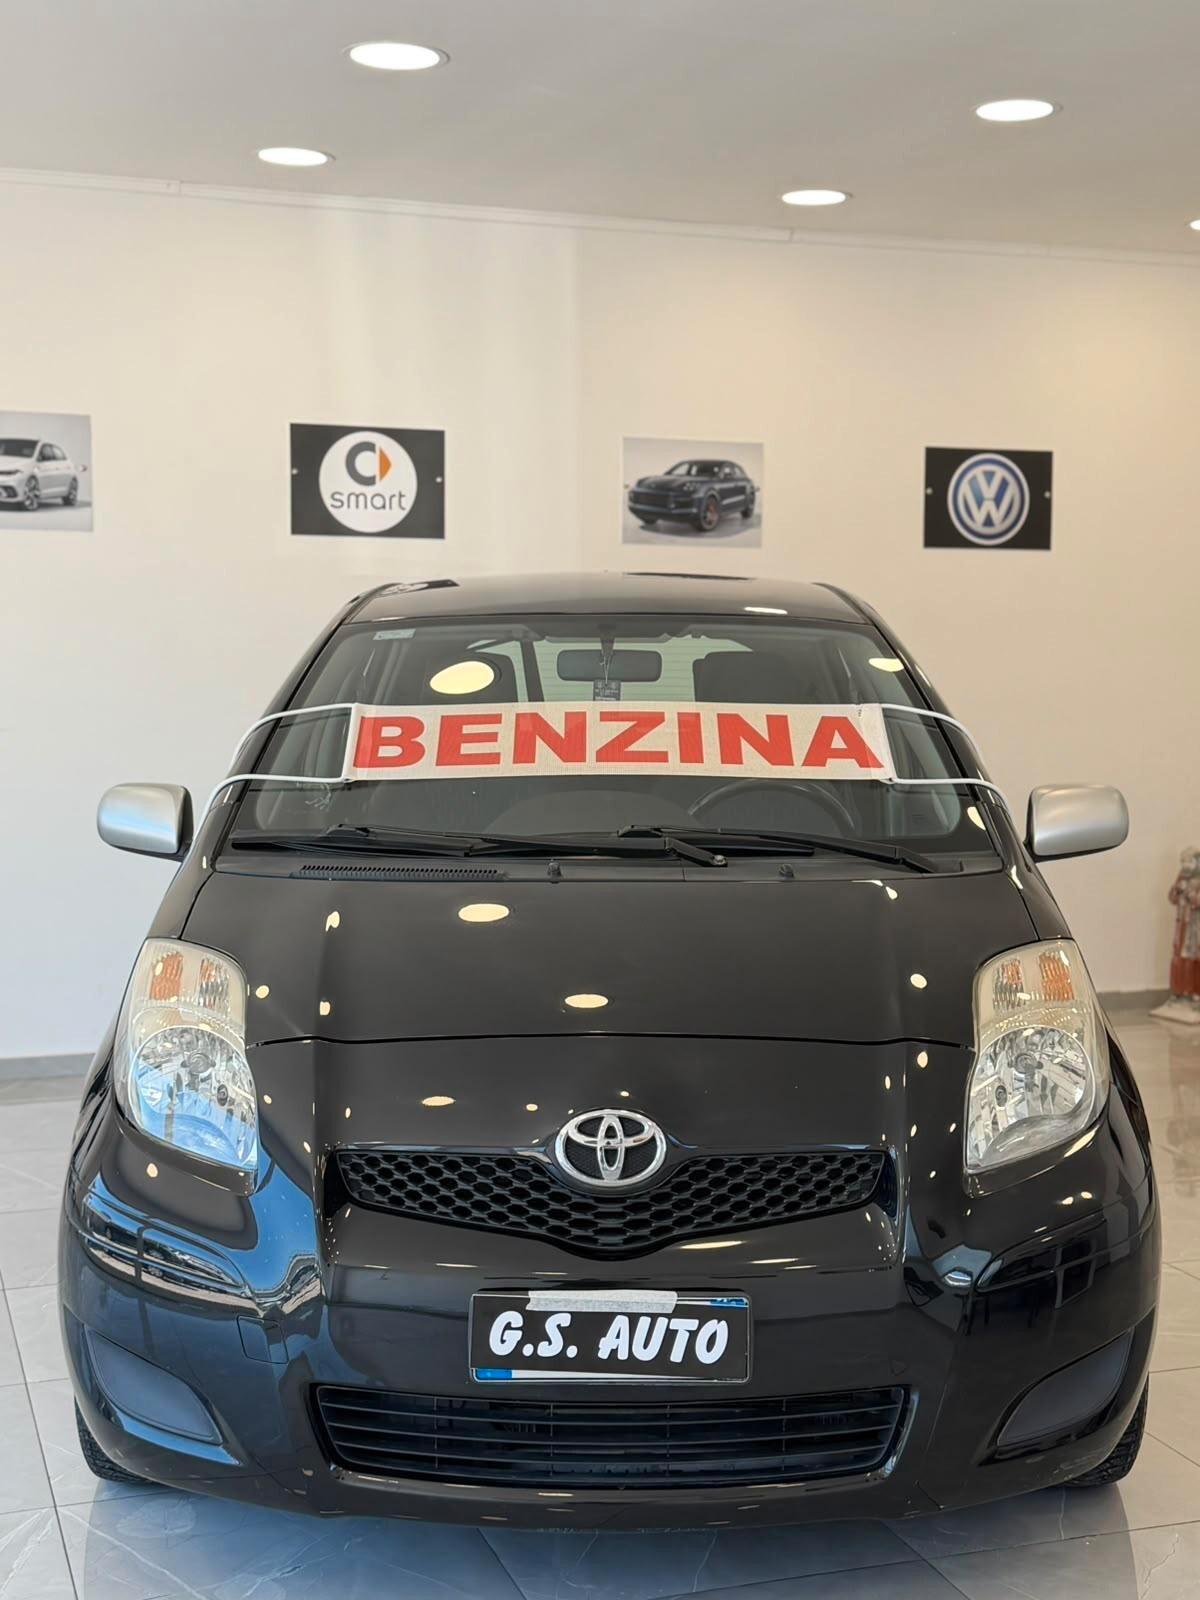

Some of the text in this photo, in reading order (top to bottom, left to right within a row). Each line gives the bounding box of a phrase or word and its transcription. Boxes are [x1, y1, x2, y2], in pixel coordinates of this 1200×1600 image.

[330, 490, 406, 511] smart
[353, 711, 884, 769] BENZINA
[489, 1310, 729, 1365] G.S. AUTO
